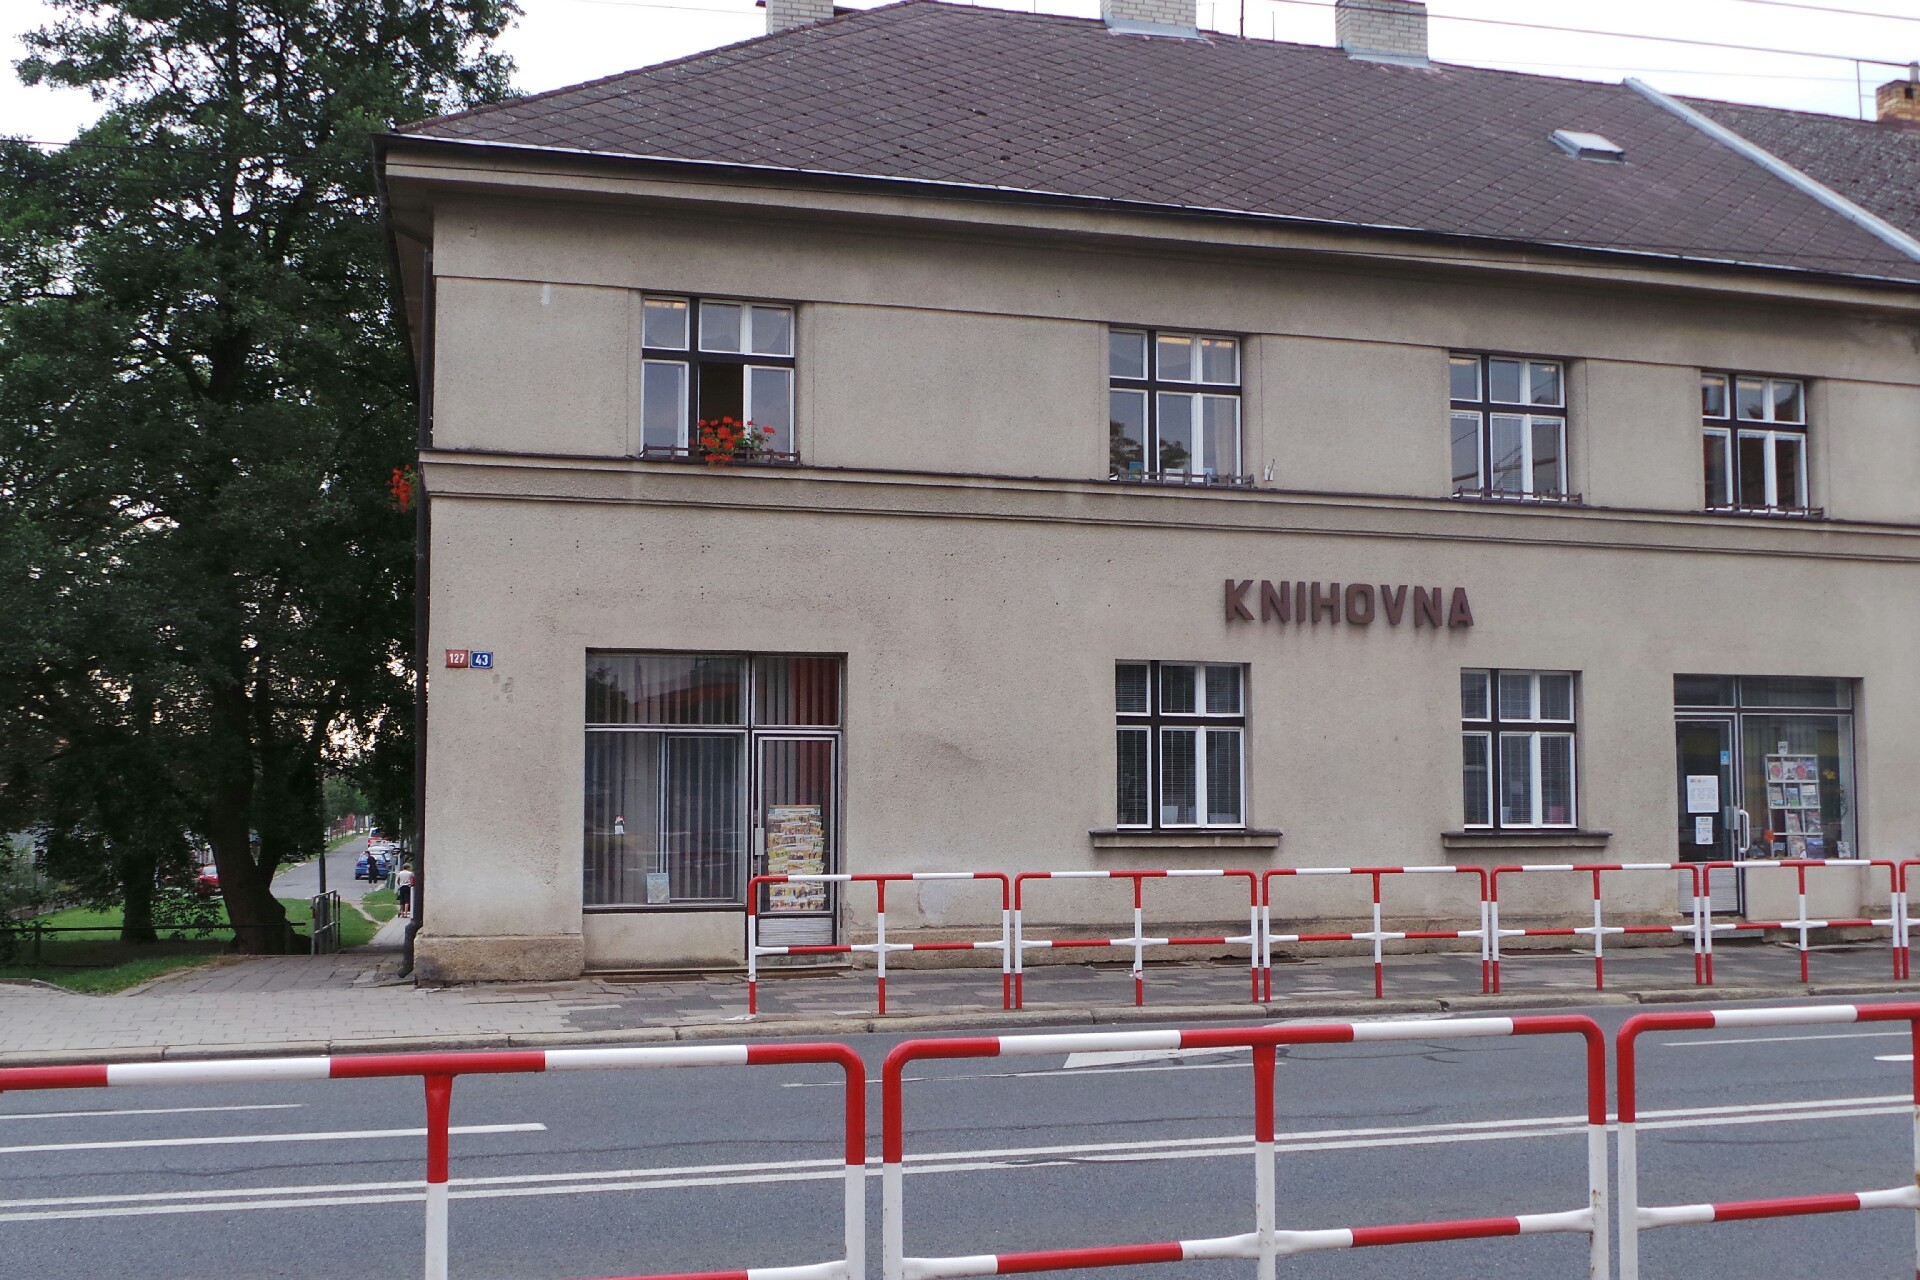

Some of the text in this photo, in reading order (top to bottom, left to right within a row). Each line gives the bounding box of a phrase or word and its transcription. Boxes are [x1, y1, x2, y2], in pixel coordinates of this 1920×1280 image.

[1225, 579, 1474, 626] KNIHOVNA
[449, 653, 465, 664] 127
[475, 654, 489, 666] 43
